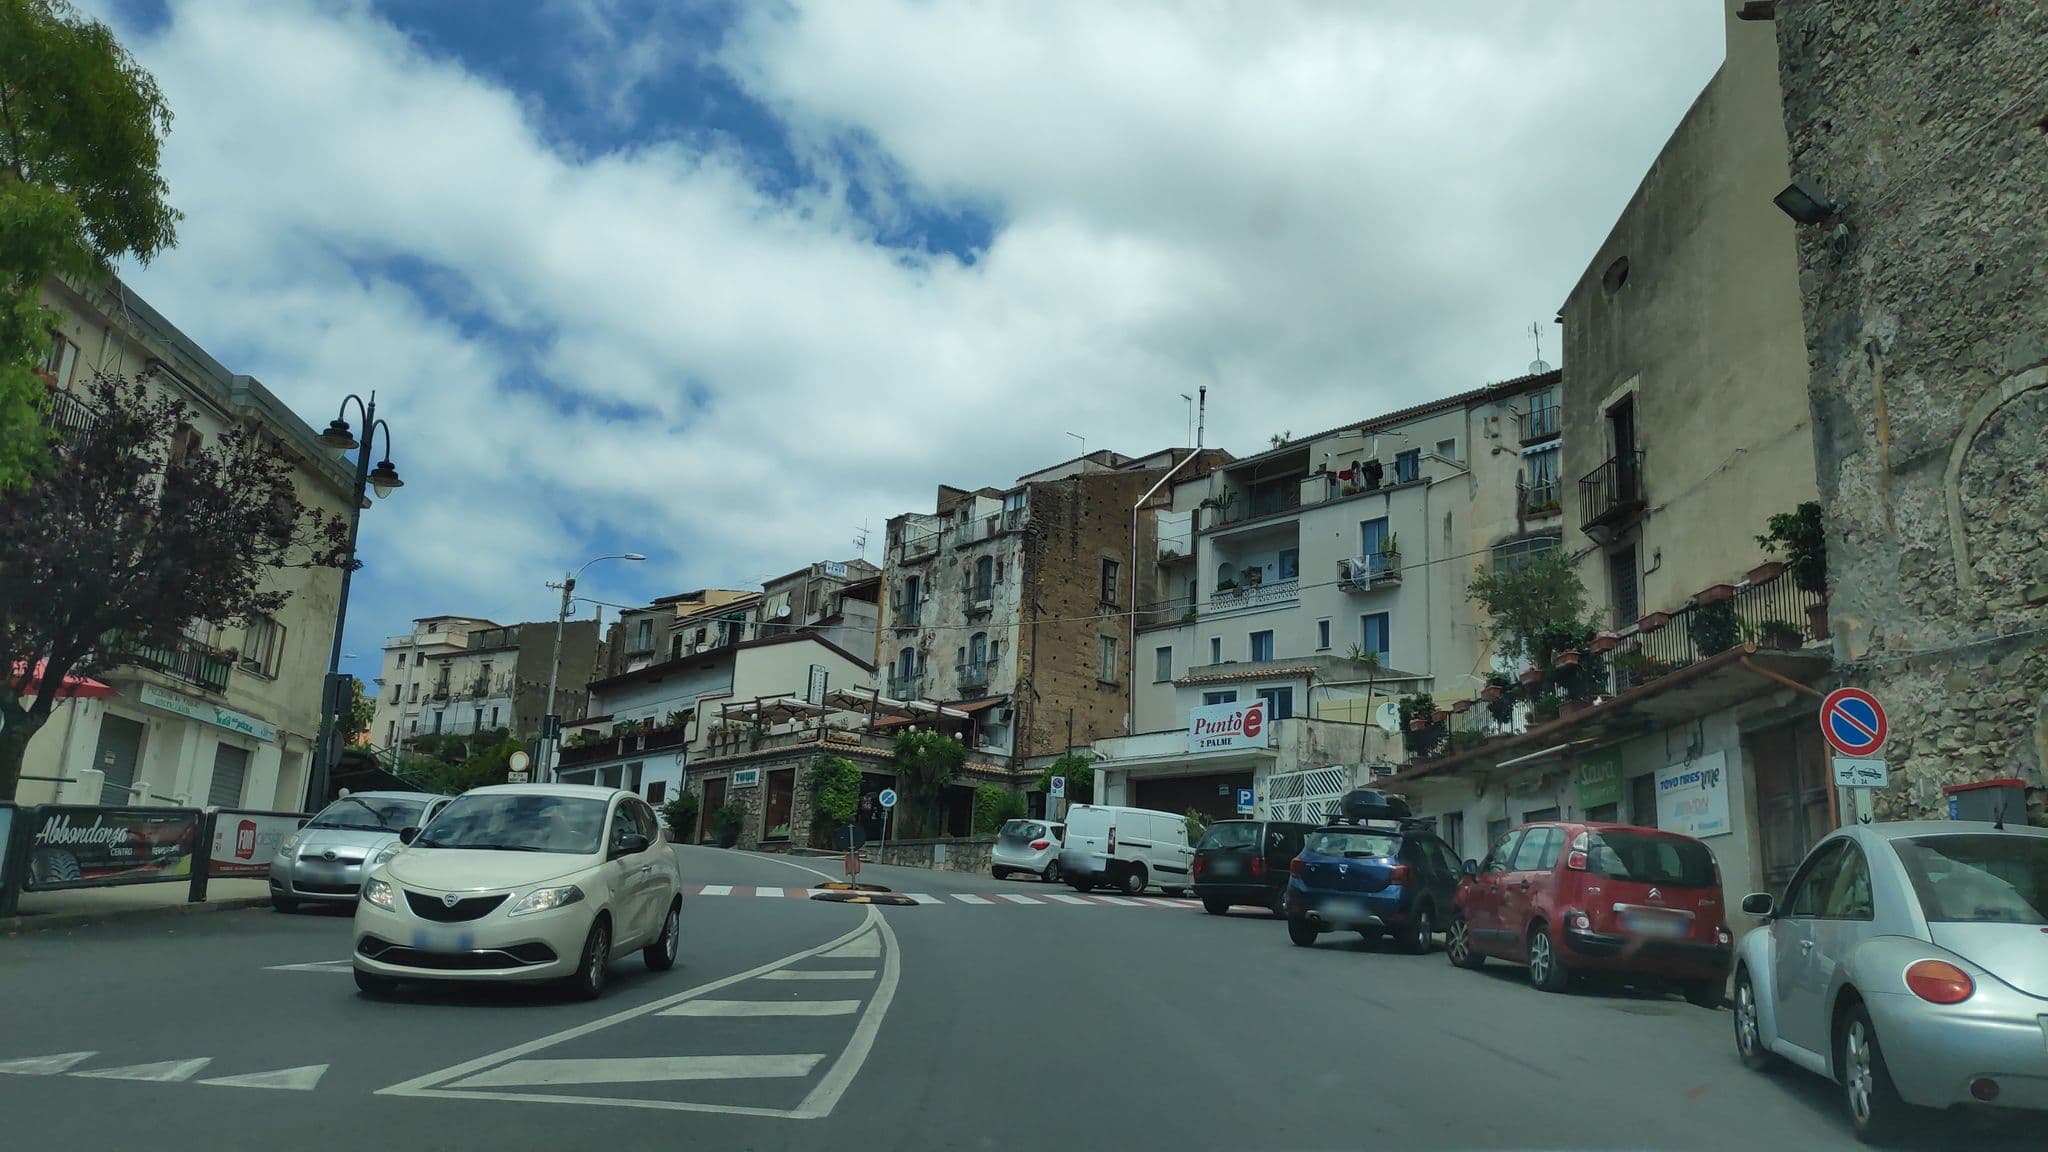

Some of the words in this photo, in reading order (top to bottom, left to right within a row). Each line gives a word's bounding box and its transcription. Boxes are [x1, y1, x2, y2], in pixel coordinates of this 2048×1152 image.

[1200, 740, 1205, 748] 2
[1206, 738, 1233, 747] PALME
[1660, 777, 1679, 790] TOYO
[1680, 770, 1700, 785] TIRES
[1240, 790, 1251, 805] P
[35, 814, 129, 848] Abbondanza
[110, 847, 133, 857] CENTRO
